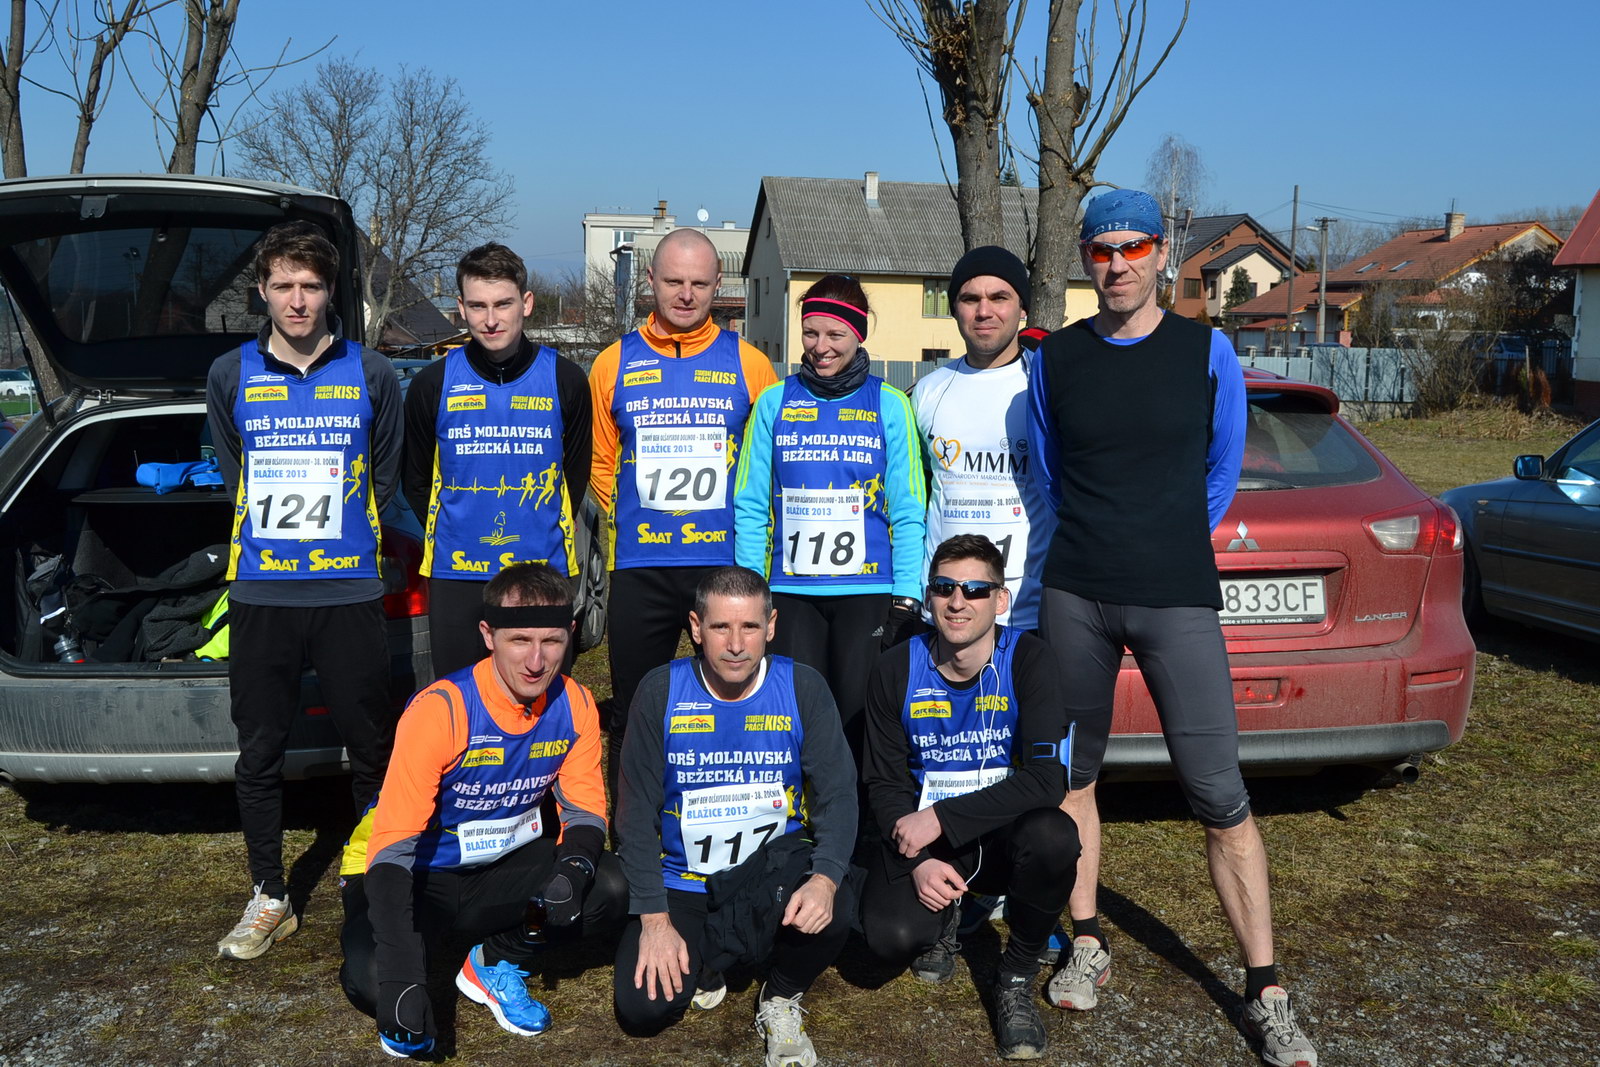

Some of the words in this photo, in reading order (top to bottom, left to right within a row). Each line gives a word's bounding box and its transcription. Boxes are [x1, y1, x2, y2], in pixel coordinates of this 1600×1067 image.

[711, 371, 737, 385] KISS
[333, 385, 360, 400] KISS
[528, 397, 553, 411] KISS
[626, 396, 649, 412] ORŠ
[653, 397, 734, 410] MOLDAVSKÁ
[245, 415, 271, 432] ORŠ
[274, 414, 361, 429] MOLDAVSKÁ
[633, 410, 691, 427] BEŽECKÁ
[695, 413, 725, 425] LIGA
[254, 431, 317, 448] BEŽECKÁ
[320, 433, 352, 445] LIGA
[448, 424, 471, 439] ORŠ
[475, 425, 552, 438] MOLDAVSKÁ
[456, 440, 511, 455] BEŽECKÁ
[513, 443, 543, 455] LIGA
[642, 444, 671, 453] BLAŽICE
[673, 445, 693, 453] 2013
[776, 432, 798, 446] ORŠ
[801, 434, 881, 449] MOLDAVSKÁ
[782, 447, 839, 462] BEŽECKÁ
[843, 450, 872, 464] LIGA
[964, 451, 1028, 475] MMM
[254, 468, 283, 478] BLAŽICE
[286, 470, 307, 478] 2013
[645, 467, 717, 501] 120
[257, 494, 331, 529] 124
[637, 523, 673, 544] SAAT
[681, 523, 727, 544] SPORT
[788, 531, 855, 566] 118
[259, 549, 299, 571] SAAT
[308, 549, 360, 571] SPORT
[452, 551, 490, 572] SAAT
[1225, 583, 1318, 613] 833CF
[1355, 612, 1408, 622] LANCER
[764, 715, 792, 731] KISS
[543, 739, 569, 757] KISS
[668, 749, 695, 766] ORŠ
[699, 747, 792, 766] MOLDAVSKÁ
[976, 745, 1005, 760] LIGA
[677, 767, 745, 783] BEŽECKÁ
[749, 770, 783, 783] LIGA
[454, 793, 518, 811] BEŽECKÁ
[764, 788, 780, 799] ROČNÍK
[687, 807, 722, 819] BLAŽICE
[725, 806, 748, 817] 2013
[465, 839, 496, 851] BLAŽICE
[500, 834, 516, 847] 2013
[694, 822, 778, 865] 117
